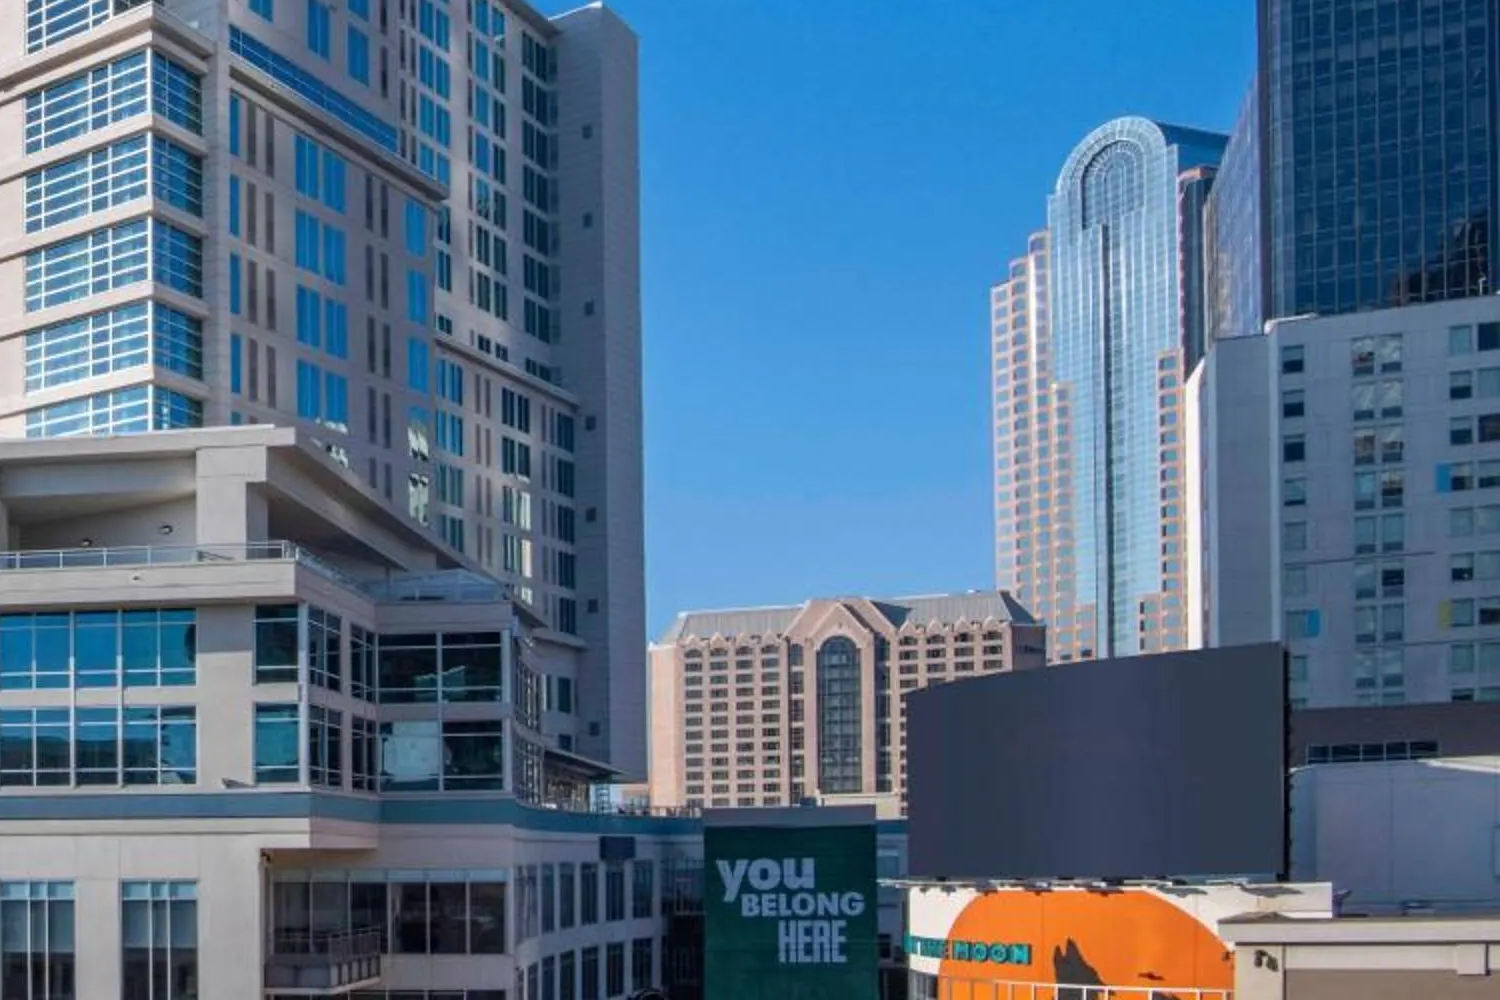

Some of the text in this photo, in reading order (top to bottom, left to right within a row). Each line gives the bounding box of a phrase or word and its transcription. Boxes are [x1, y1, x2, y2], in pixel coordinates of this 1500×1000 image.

[741, 892, 865, 917] BELONG
[778, 920, 847, 963] HERE
[953, 940, 1030, 965] MOON
